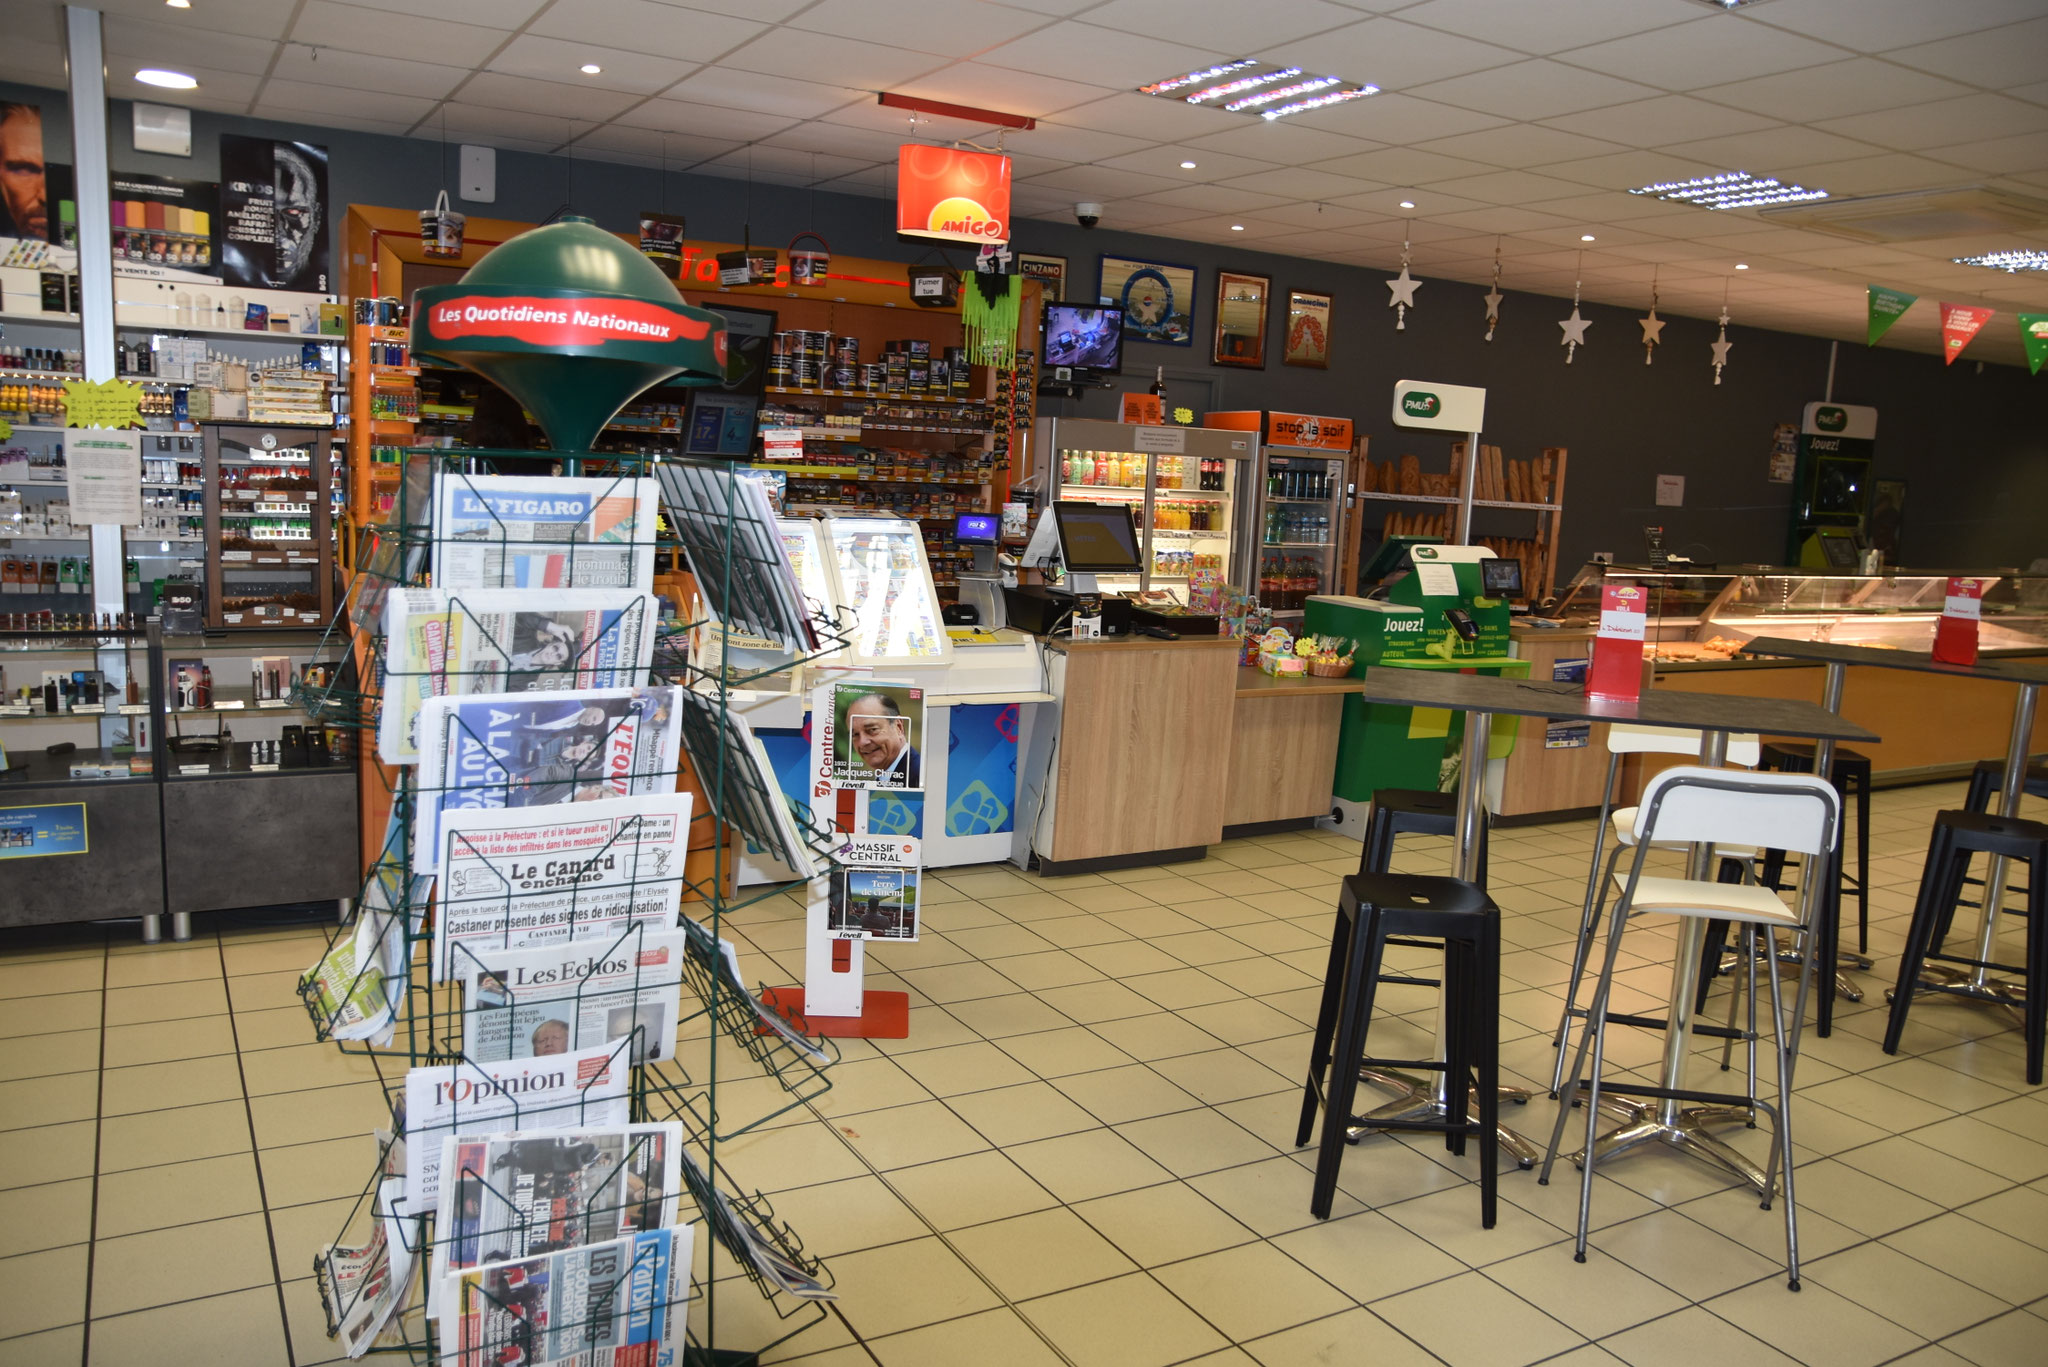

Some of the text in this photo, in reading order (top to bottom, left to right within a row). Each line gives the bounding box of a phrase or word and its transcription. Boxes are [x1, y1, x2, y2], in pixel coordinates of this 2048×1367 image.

[229, 181, 274, 195] KRYOS
[248, 198, 274, 207] FRUIT
[940, 216, 1001, 237] AMIGO
[228, 233, 274, 244] COMPLEXE
[126, 268, 149, 276] VENTE
[1023, 262, 1061, 275] CINZANO
[1293, 298, 1329, 308] ORANGINA
[439, 306, 670, 338] Les Quotidiens Nationaux
[1276, 421, 1345, 436] stop la soif
[1810, 437, 1840, 451] Jouez!
[463, 498, 584, 516] LE FIGARO
[577, 572, 590, 585] le
[1384, 618, 1424, 632] Jouez!
[427, 621, 444, 672] CAMPING
[761, 641, 771, 649] de
[487, 709, 520, 764] À LA
[649, 728, 662, 762] Mbappé
[834, 768, 904, 779] Jacques Chirac
[495, 832, 502, 842] la
[503, 829, 537, 841] Préfecture
[543, 828, 549, 838] et
[551, 827, 557, 837] si
[558, 827, 565, 836] le
[565, 826, 582, 835] tueur
[583, 824, 599, 834] avait
[643, 831, 651, 839] en
[653, 830, 672, 840] panne
[482, 845, 488, 854] la
[490, 844, 504, 854] liste
[506, 843, 518, 853] des
[519, 840, 544, 852] infiltrés
[546, 839, 561, 849] dans
[562, 838, 572, 847] les
[856, 843, 896, 852] MASSIF
[849, 852, 901, 862] CENTRAL
[511, 854, 616, 880] Le Canard
[872, 880, 896, 888] Terre
[449, 908, 470, 917] Après
[480, 906, 499, 914] tueur
[511, 903, 518, 911] la
[520, 899, 556, 910] Préfecture
[557, 898, 566, 907] de
[602, 894, 614, 902] cas
[447, 917, 493, 934] Castaner
[540, 910, 556, 925] des
[558, 906, 589, 924] signes
[591, 905, 603, 919] de
[516, 966, 557, 985] Les
[560, 956, 628, 982] Echos
[479, 1013, 495, 1022] Les
[478, 1035, 488, 1043] de
[435, 1070, 565, 1106] l'Opinion
[514, 1174, 535, 1211] DE TOUS
[589, 1246, 618, 1276] LES
[630, 1238, 666, 1328] Le Parisien
